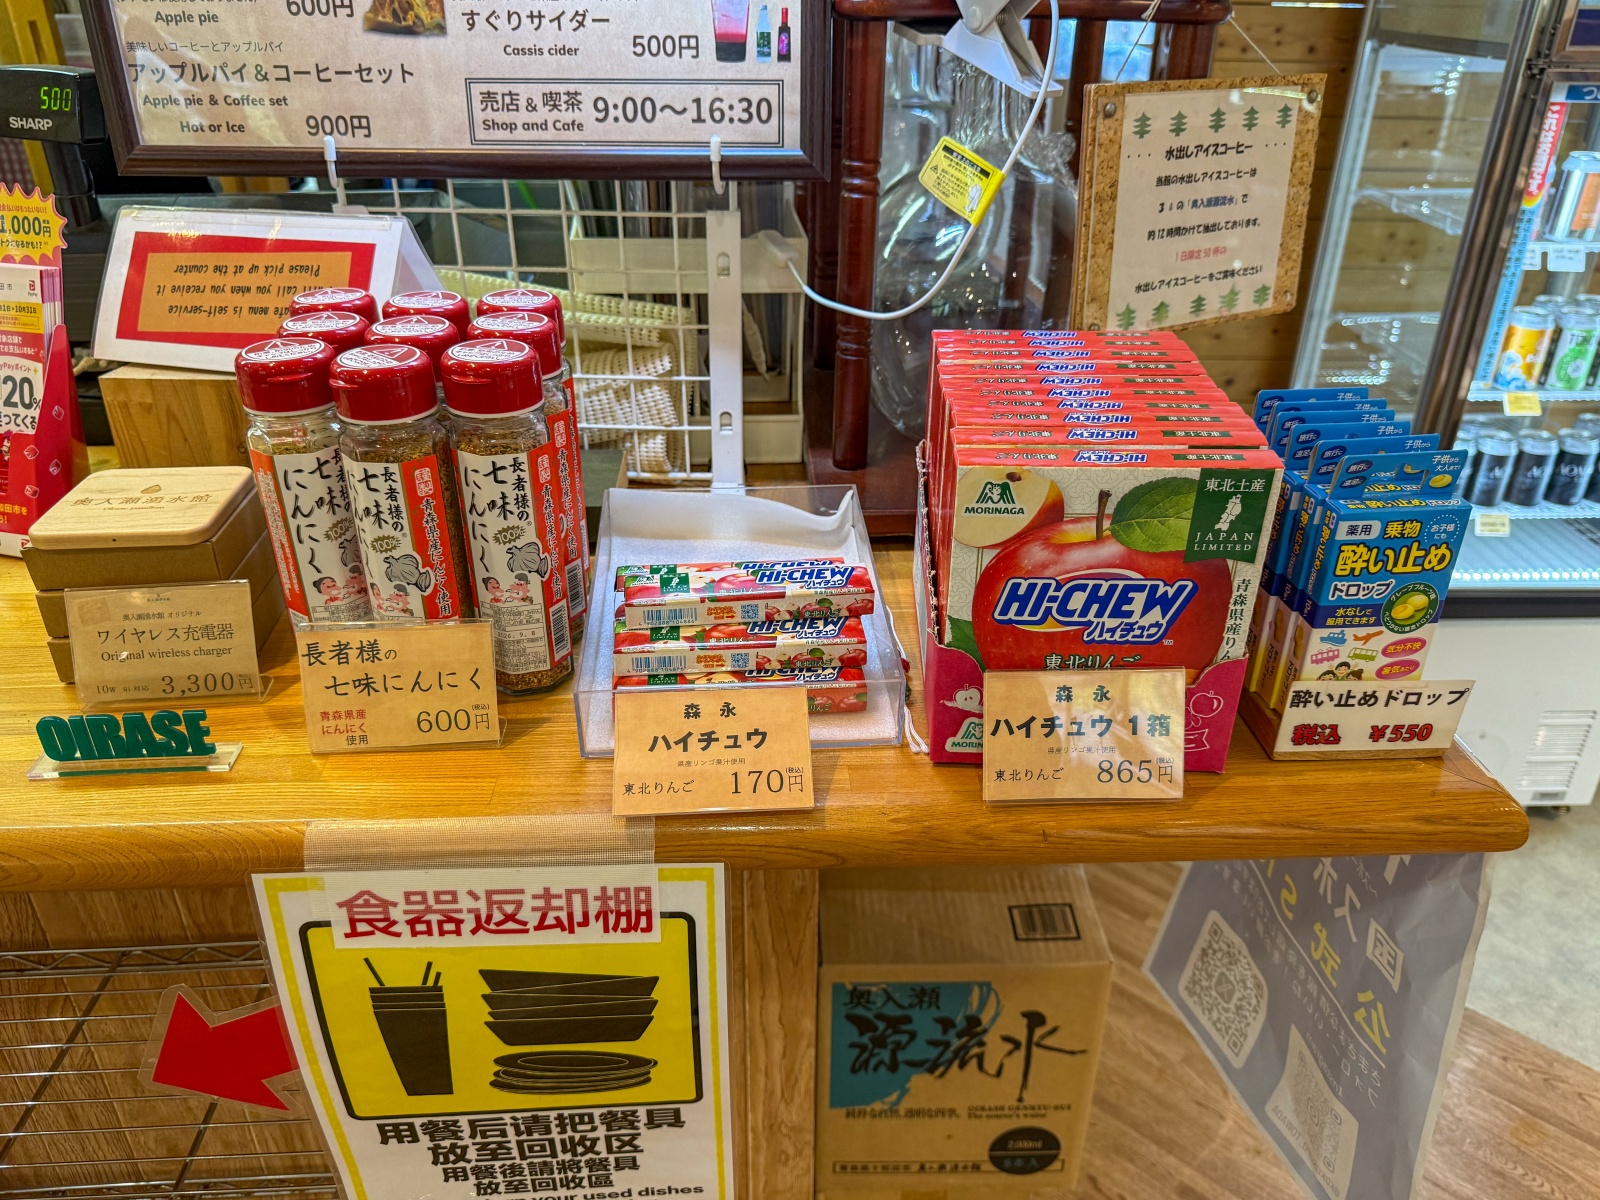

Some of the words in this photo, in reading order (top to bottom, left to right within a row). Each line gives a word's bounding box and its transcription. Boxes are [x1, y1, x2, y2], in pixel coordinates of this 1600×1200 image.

[155, 11, 193, 27] Apple
[195, 11, 219, 27] pie
[461, 9, 610, 32] すぐりサイダー
[126, 41, 284, 54] 美味しいコーヒーとアップルパイ
[503, 44, 544, 56] Cassis
[548, 44, 580, 56] cider
[632, 35, 699, 59] 500円
[40, 86, 72, 111] 500
[143, 94, 180, 108] Apple
[183, 94, 204, 108] pie
[209, 95, 218, 106] &
[224, 94, 266, 107] Coffee
[269, 95, 289, 107] set
[9, 116, 53, 131] SHARP
[180, 121, 205, 134] Hot
[209, 123, 222, 134] or
[226, 121, 246, 134] Ice
[306, 115, 372, 138] 900円
[482, 120, 517, 134] Shop
[522, 119, 549, 131] and
[553, 119, 584, 131] Cafe
[1164, 141, 1253, 161] 水出しアイスコーヒー
[1155, 168, 1258, 187] 当館の水出しアイスコーヒーは
[174, 265, 208, 276] counter
[213, 265, 228, 276] the
[233, 265, 244, 276] at
[250, 264, 258, 275] up
[262, 264, 284, 277] pick
[290, 264, 320, 278] Please
[156, 285, 166, 297] it
[170, 285, 206, 297] receive
[211, 284, 226, 295] you
[231, 285, 252, 297] when
[256, 284, 272, 295] you
[277, 285, 297, 297] call
[168, 306, 229, 318] self-service
[233, 306, 243, 317] is
[248, 306, 269, 316] menu
[274, 306, 290, 318] afe
[2, 375, 41, 411] 20%
[1047, 388, 1111, 399] HI-CHEW
[1063, 412, 1132, 424] HI-CHEW
[1067, 428, 1138, 441] HI-CHEW
[1073, 450, 1147, 464] HI-CHEW
[308, 458, 343, 516] 七味
[483, 461, 515, 521] 七味
[509, 457, 530, 522] 長者様の
[1204, 477, 1267, 493] 東北土産
[357, 468, 390, 530] 七味
[380, 467, 405, 533] 長者様の
[964, 505, 1025, 515] MORINAGA
[284, 469, 323, 575] にんにく
[464, 467, 490, 574] にんにく
[1431, 523, 1455, 533] お子様
[1194, 531, 1255, 542] JAPAN
[1345, 524, 1373, 536] 薬用
[1384, 521, 1422, 540] 乗物
[541, 485, 563, 599] 青森県産にんにく使用
[1193, 543, 1252, 552] LIMITED
[420, 498, 452, 617] 青森県産にんにく使用
[1335, 542, 1454, 576] 酔い止め
[756, 566, 855, 584] HI-CHEW
[806, 579, 845, 589] ハイチュウ
[1329, 579, 1396, 600] ドロップ
[995, 579, 1205, 626] HI-CHEW
[168, 610, 202, 620] オリジナル
[804, 609, 841, 618] 東北りんご
[1335, 607, 1373, 617] 水なしで
[1325, 616, 1377, 626] 服用できます
[97, 623, 234, 645] ワイヤレス充電器
[796, 630, 837, 639] ハイチュウ
[1083, 620, 1167, 643] ハイチュウ
[101, 650, 145, 664] Original
[148, 648, 191, 659] wireless
[193, 646, 232, 659] charger
[301, 639, 397, 667] 長者様の
[161, 672, 254, 697] 3,300円
[324, 667, 481, 697] 七味にんにく
[1055, 685, 1111, 703] 森永
[1289, 688, 1470, 709] 酔い止めドロップ
[320, 709, 367, 721] 青森県産
[684, 702, 737, 720] 森永
[322, 722, 368, 735] にんにく
[416, 708, 489, 733] 600円
[990, 715, 1113, 739] ハイチュウ
[1128, 714, 1171, 737] 1箱
[36, 710, 217, 762] OIRASE
[346, 735, 369, 746] 使用
[648, 728, 768, 752] ハイチュウ
[1291, 723, 1342, 746] 税込
[1368, 723, 1434, 743] ¥550
[1047, 746, 1116, 755] 県産リンゴ果汁使用
[677, 758, 746, 767] 県産リンゴ果汁使用
[993, 767, 1064, 782] 東北りんご
[1097, 759, 1173, 784] 865円
[622, 779, 695, 796] 東北りんご
[731, 769, 804, 794] 170円
[336, 886, 655, 938] 食器返却棚
[376, 1104, 686, 1146] 用餐后请把餐具
[427, 1132, 644, 1167] 放至回收区
[442, 1155, 640, 1182] 用餐後請將餐具
[473, 1172, 615, 1197] 放至回收區
[583, 1187, 633, 1200] used
[637, 1184, 704, 1197] dishes
